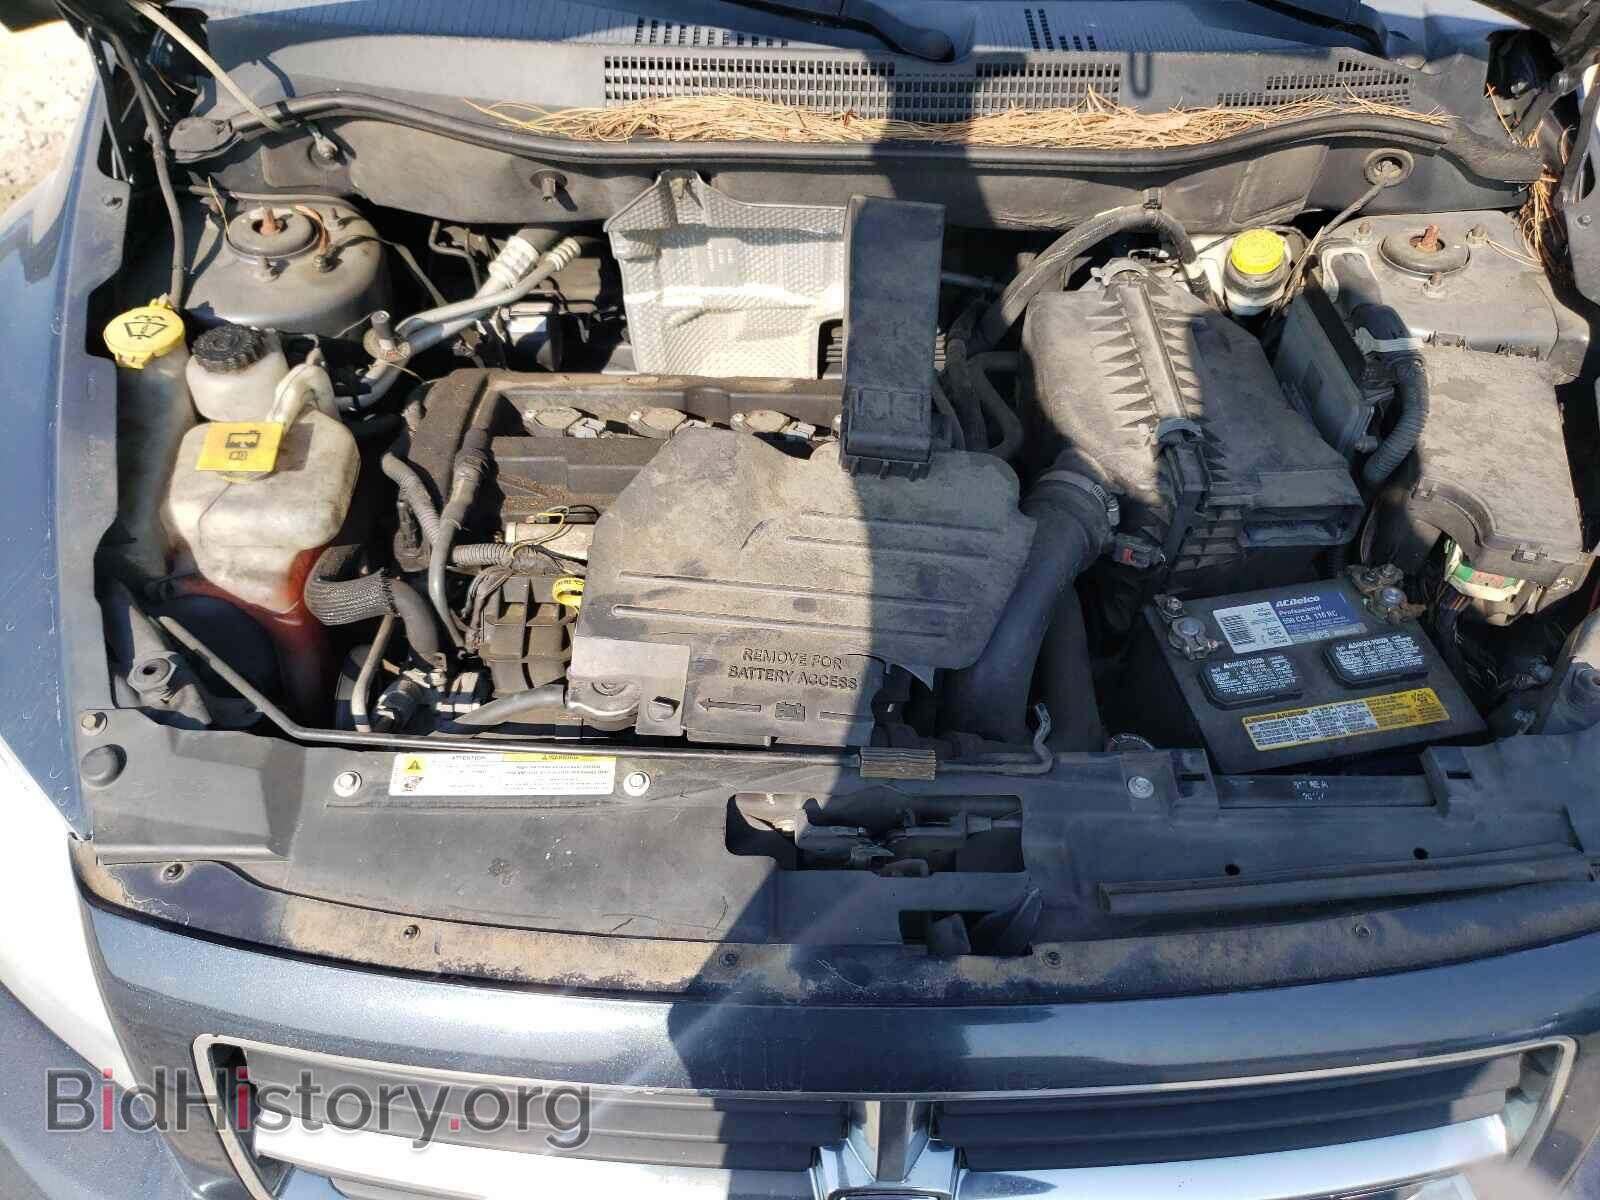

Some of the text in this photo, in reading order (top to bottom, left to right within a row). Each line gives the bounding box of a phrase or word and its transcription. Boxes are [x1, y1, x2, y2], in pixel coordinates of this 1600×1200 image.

[1275, 596, 1320, 607] ACDelco
[1278, 605, 1322, 616] Professional
[1296, 614, 1312, 624] CCA
[1326, 610, 1338, 619] RC
[743, 647, 843, 671] REMOVE FOR
[727, 664, 858, 690] BATTERY ACCESS
